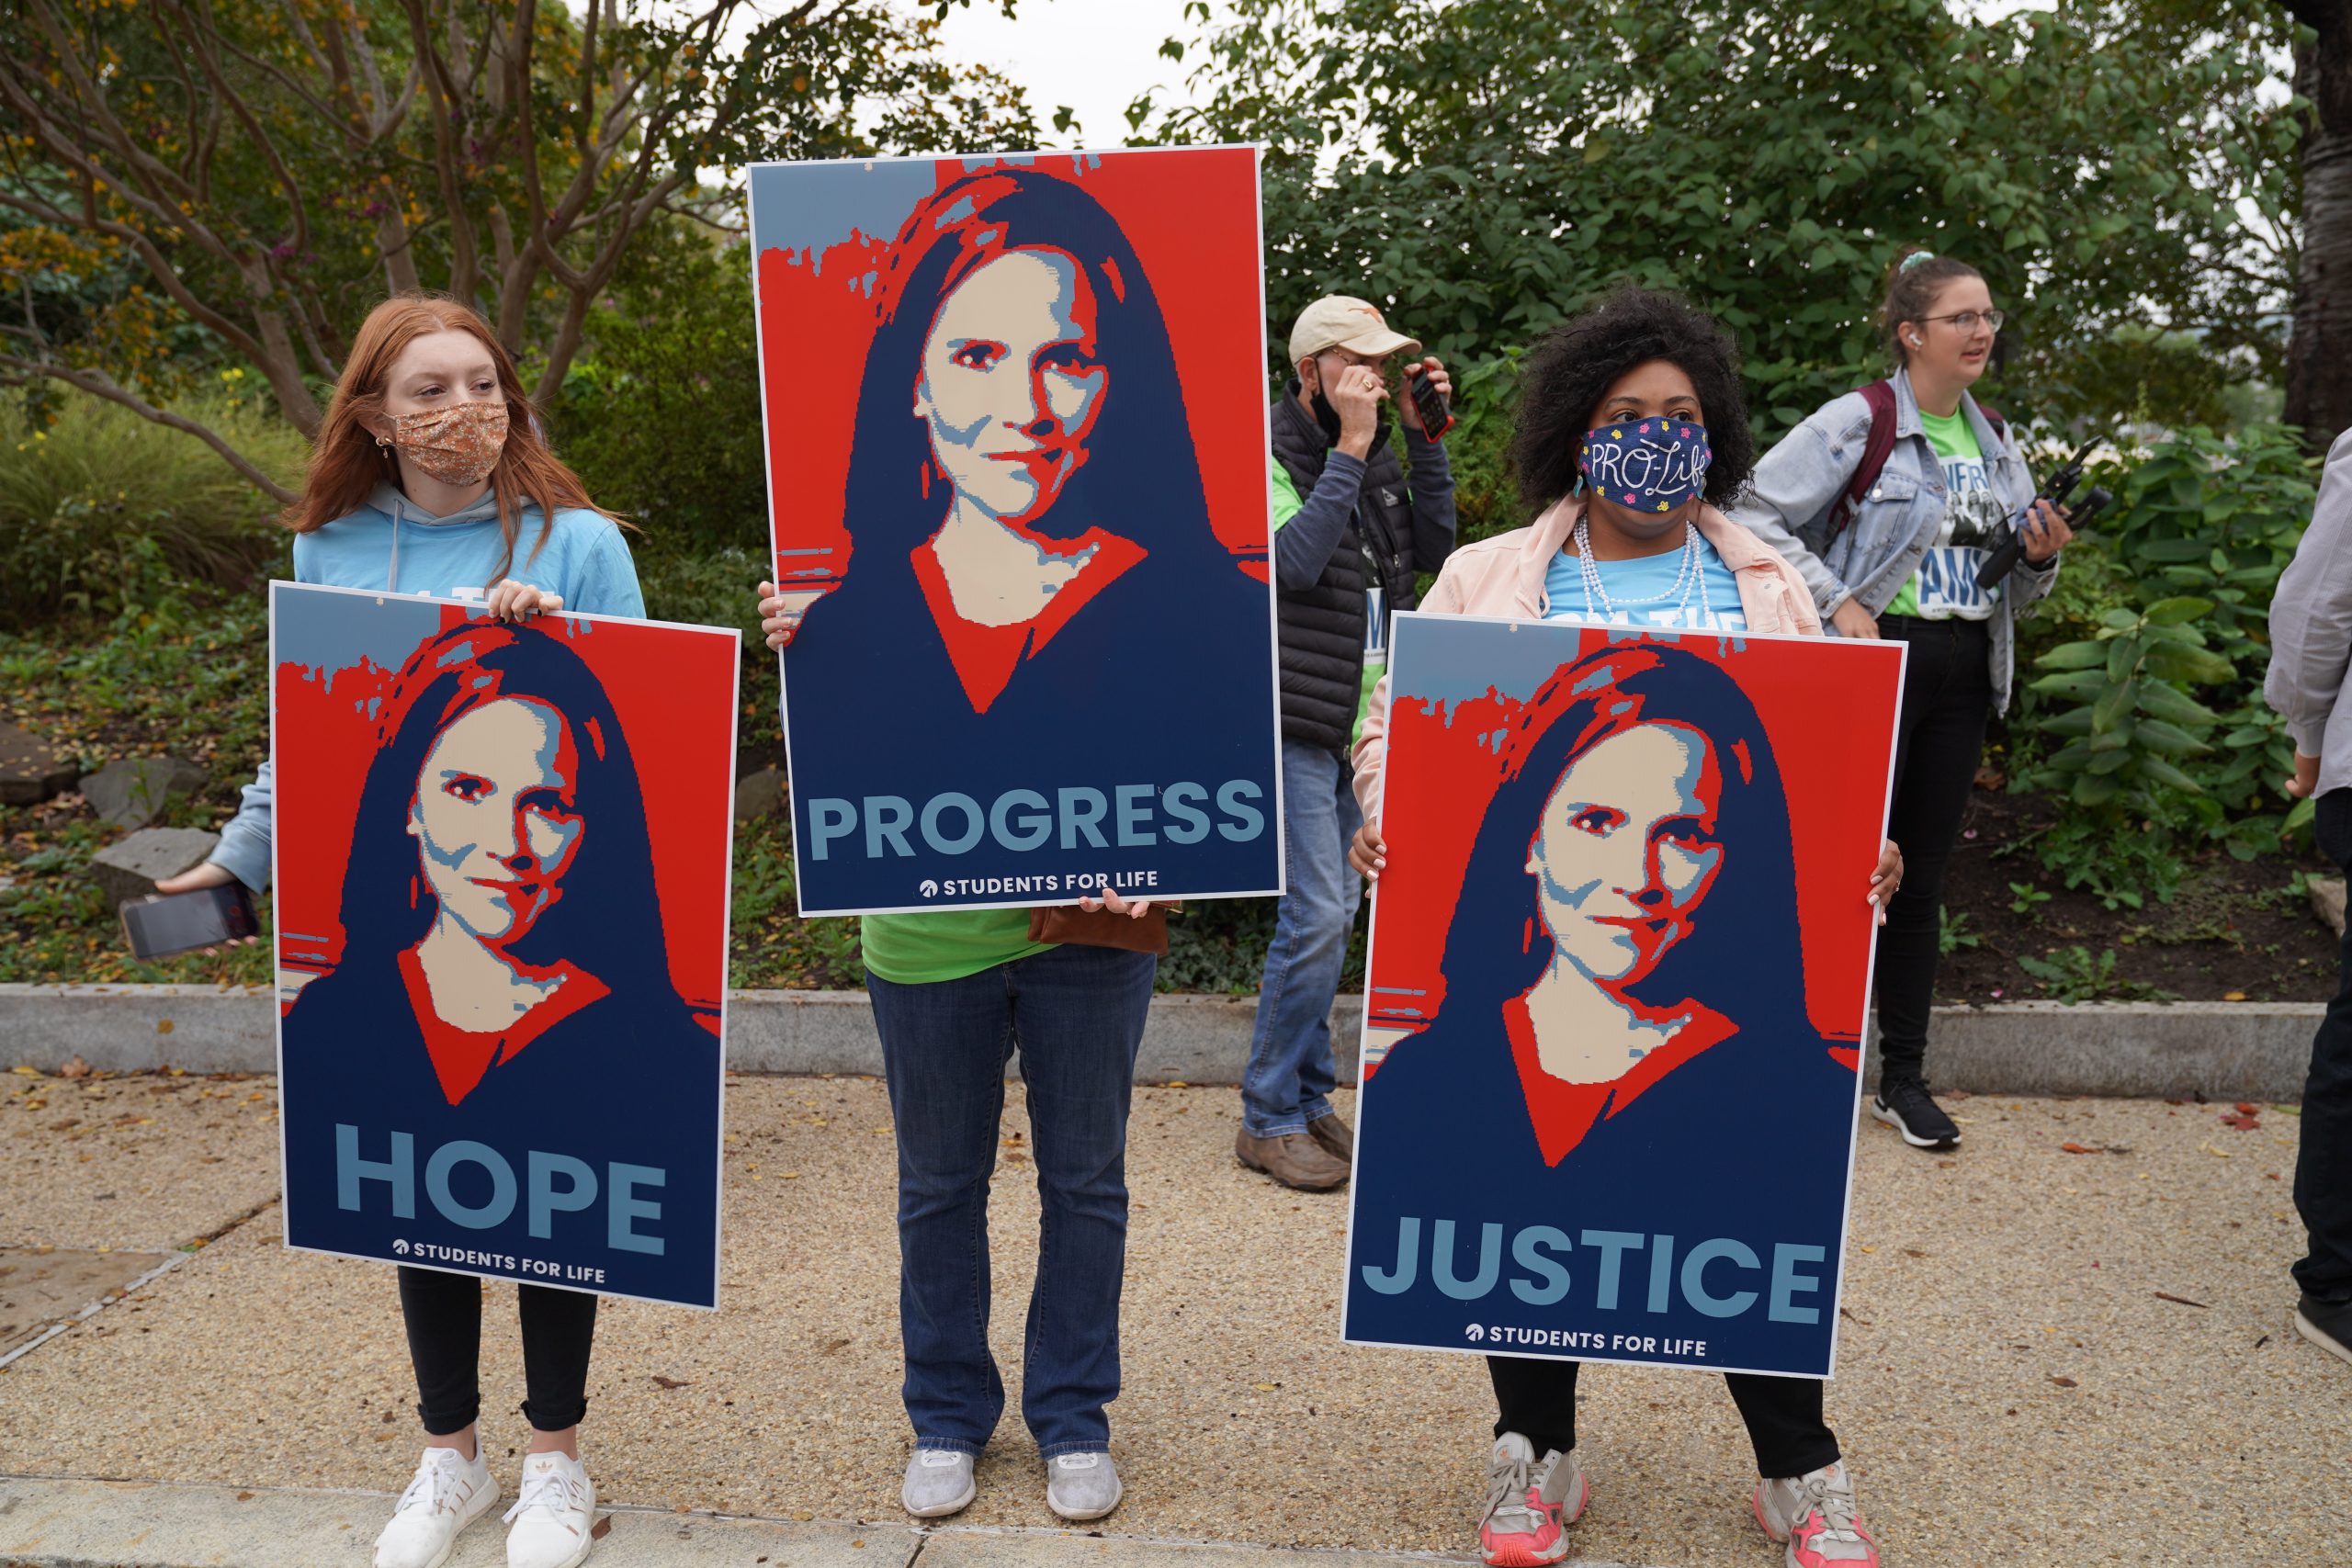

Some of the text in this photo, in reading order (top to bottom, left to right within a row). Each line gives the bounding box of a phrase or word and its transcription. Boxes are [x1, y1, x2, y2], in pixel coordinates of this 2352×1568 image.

[808, 780, 1264, 861] PROGRESS
[944, 870, 1158, 896] STUDENTS FOR LIFE
[335, 1122, 666, 1256] HOPE
[413, 1242, 605, 1284] STUDENTS FOR LIFE
[1362, 1216, 1826, 1325] JUSTICE
[1489, 1325, 1707, 1357] STUDENTS FOR LIFE
